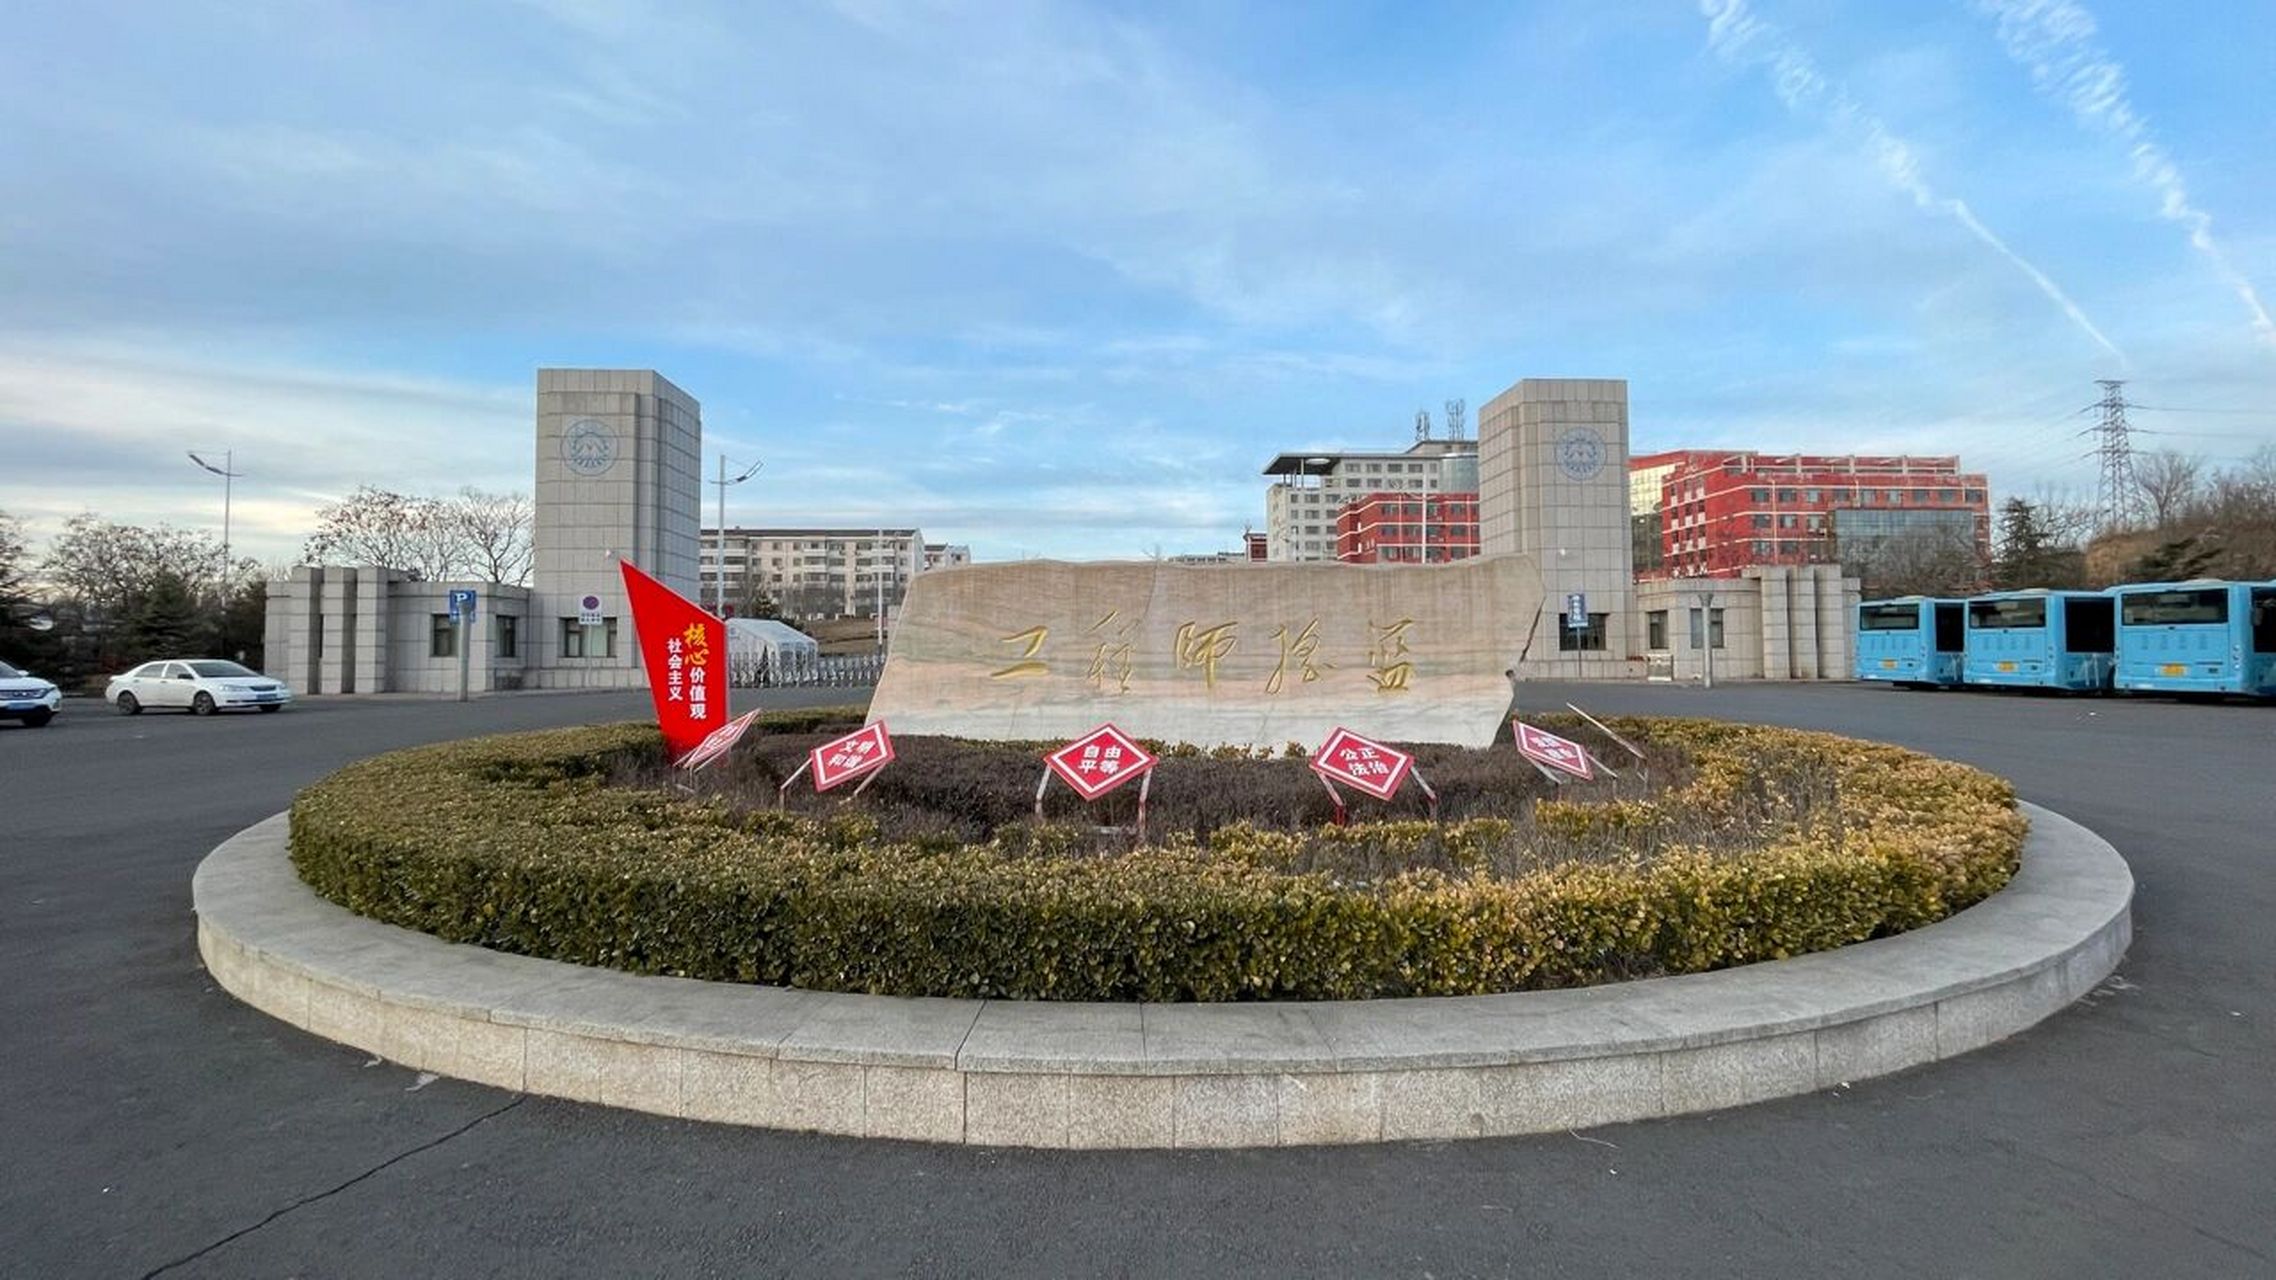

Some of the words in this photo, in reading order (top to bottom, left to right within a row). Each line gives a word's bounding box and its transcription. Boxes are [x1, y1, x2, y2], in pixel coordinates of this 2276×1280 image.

[667, 638, 683, 701] 社会主义
[684, 623, 709, 719] 核心价值观
[1083, 745, 1121, 758] 自由
[1339, 747, 1380, 760] 公正
[1078, 759, 1119, 774] 平等
